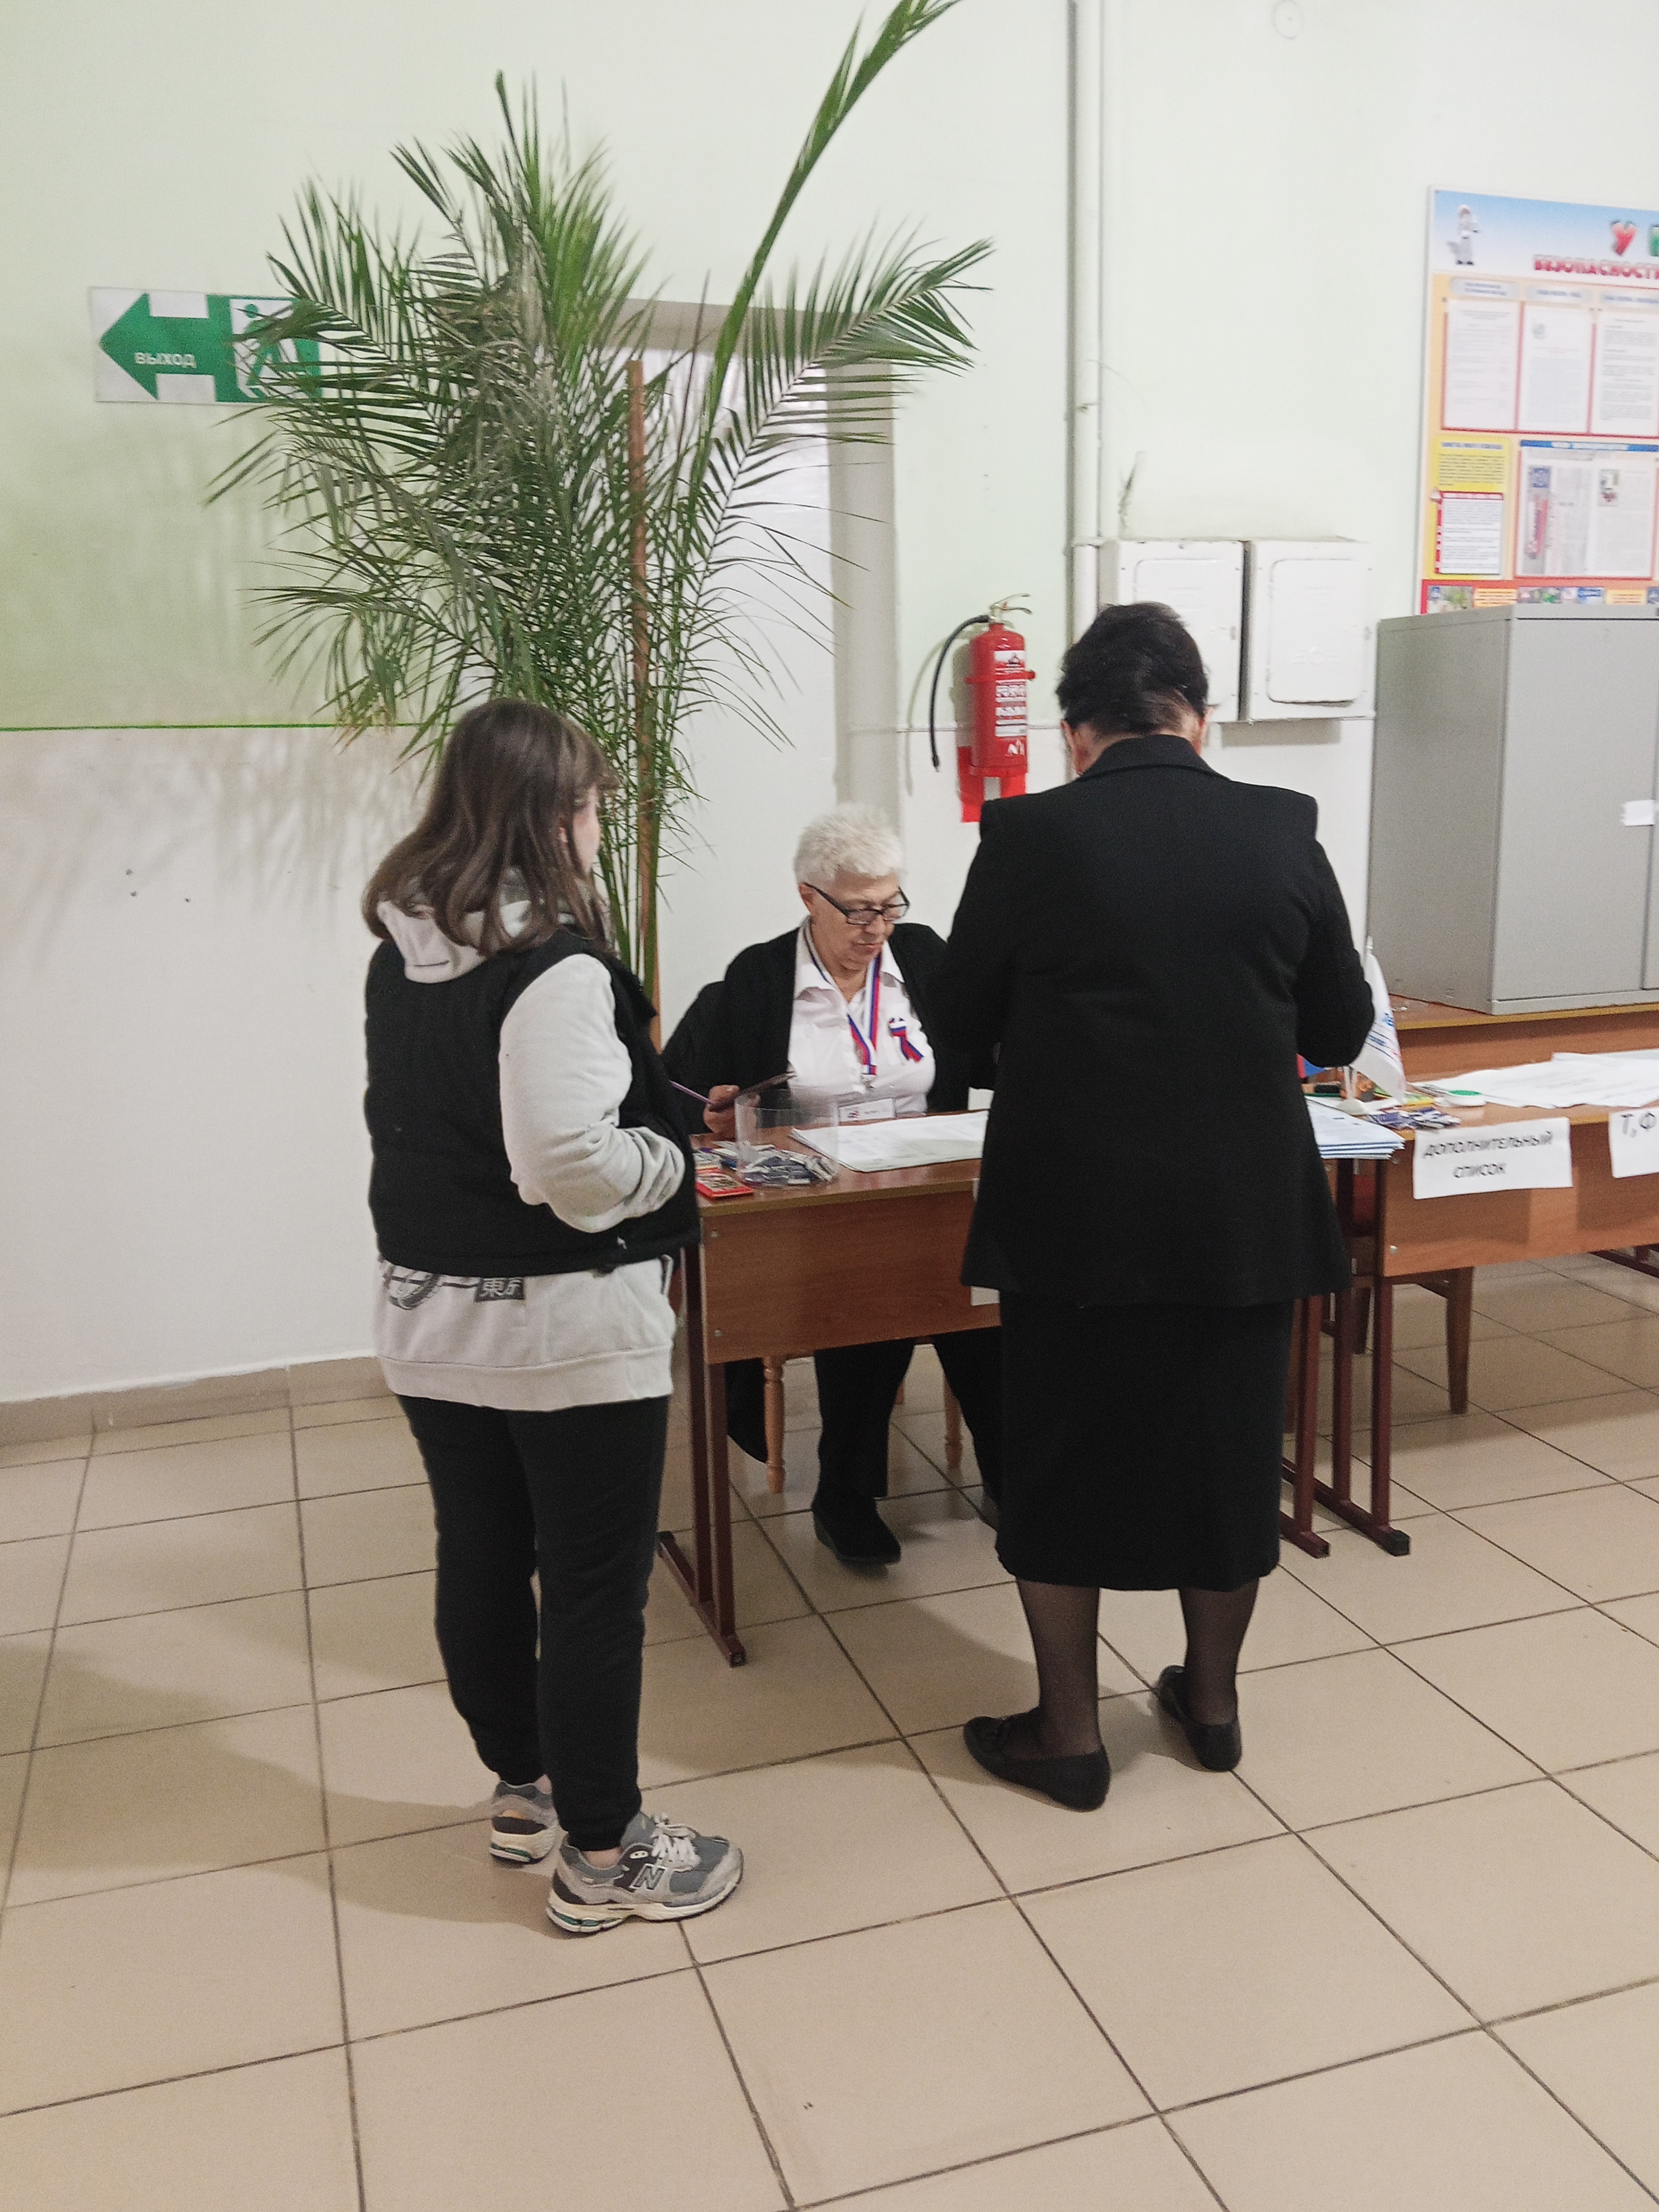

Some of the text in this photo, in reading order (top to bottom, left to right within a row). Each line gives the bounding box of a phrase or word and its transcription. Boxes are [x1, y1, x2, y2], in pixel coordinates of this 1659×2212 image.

[134, 352, 197, 369] ВЫХОД
[1421, 1130, 1553, 1159] ДОПОЛНИТЕЛЬНЫЙ
[1453, 1162, 1507, 1178] СПИСОК
[630, 1863, 667, 1891] N
